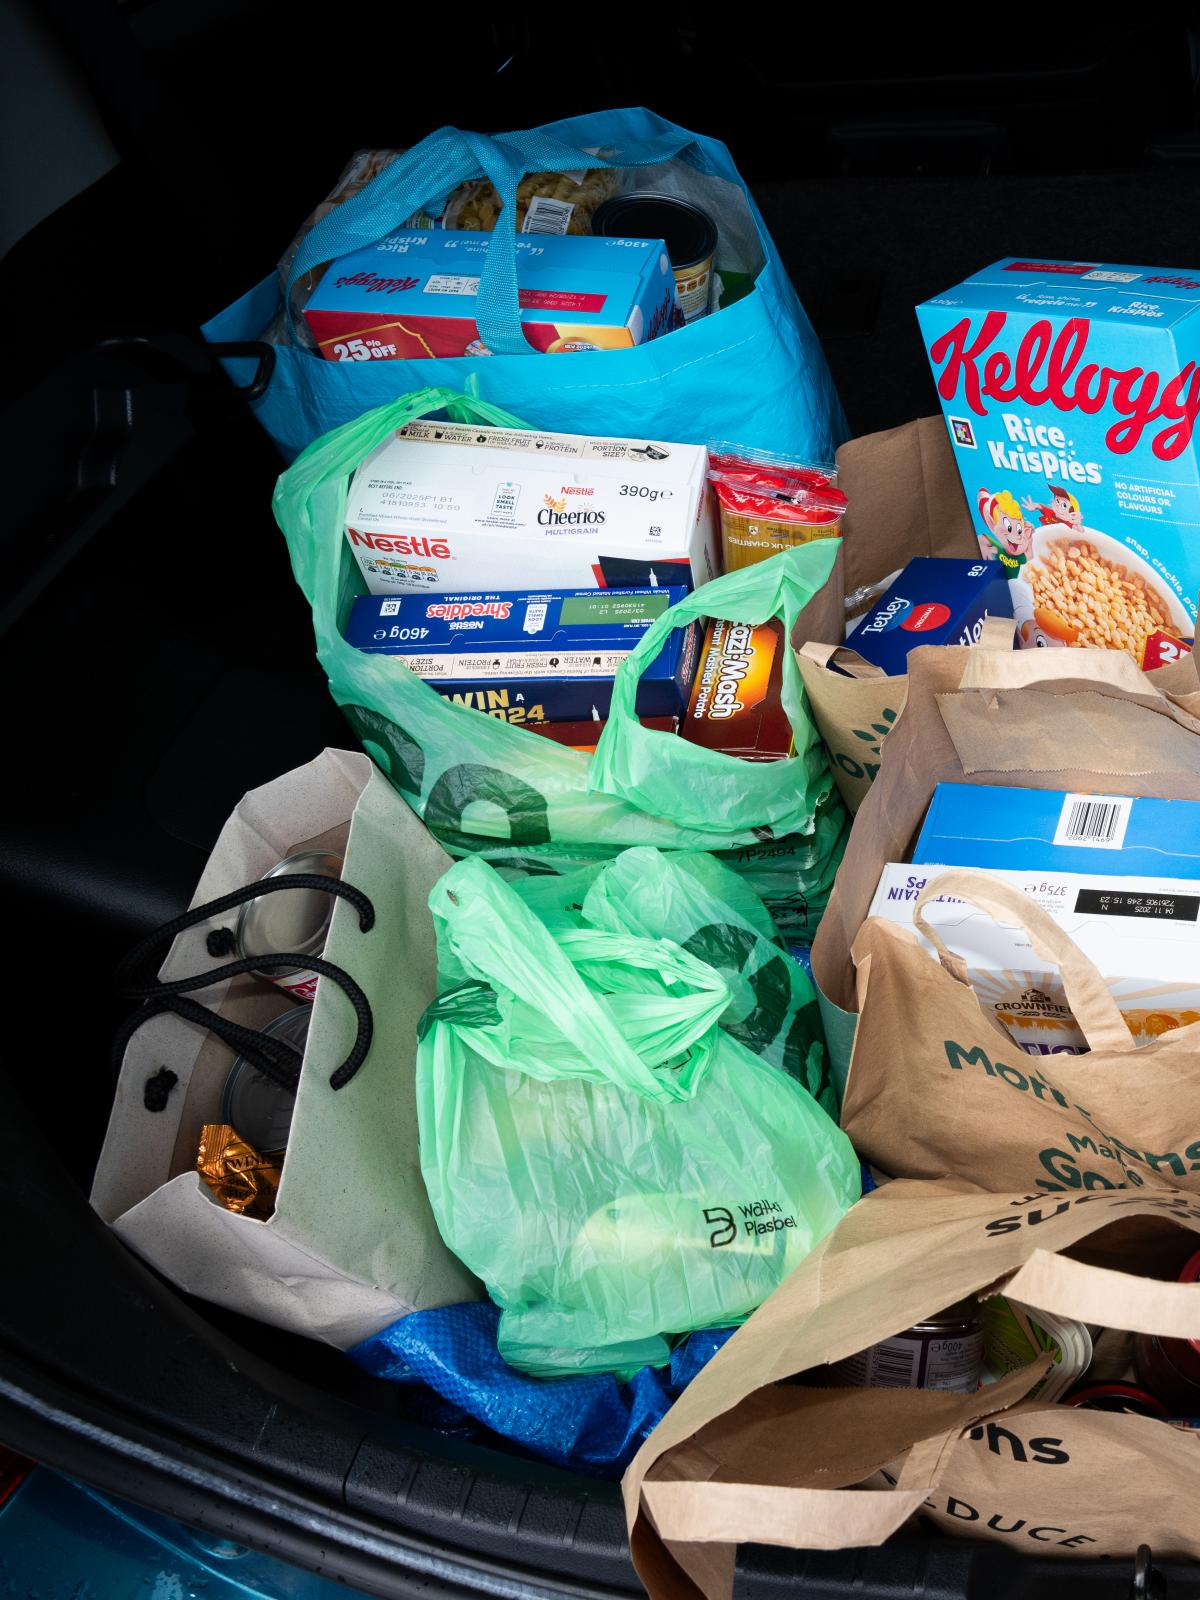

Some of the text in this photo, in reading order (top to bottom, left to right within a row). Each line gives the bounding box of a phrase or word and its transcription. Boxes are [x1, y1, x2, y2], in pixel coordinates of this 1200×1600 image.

[377, 244, 409, 253] Rice
[335, 271, 421, 294] Kellogg's
[1107, 305, 1165, 319] Krispies
[1130, 300, 1157, 311] Rice
[333, 339, 372, 361] 25
[371, 343, 398, 359] OFF
[408, 431, 430, 439] MILK
[1001, 413, 1067, 449] Rice
[444, 434, 472, 443] WATER
[488, 435, 532, 446] FRESH FRUIT
[544, 444, 579, 454] PROTEIN
[592, 445, 628, 453] PORTION
[987, 440, 1102, 486] Krispies
[1114, 481, 1176, 498] NO ARTIFICIAL
[1116, 491, 1171, 507] COLOURS OR
[1118, 501, 1163, 515] FLAVOURS
[537, 508, 606, 526] Cheerios
[545, 527, 599, 536] MULTIGRAIN
[728, 536, 766, 549] CHARITIES
[770, 542, 785, 550] UK
[968, 565, 983, 577] 80
[1125, 536, 1150, 560] snap,
[1152, 557, 1183, 596] crackle,
[426, 602, 513, 620] Shreddies
[861, 596, 910, 636] Tetley
[913, 606, 936, 629] ORIGINAL
[389, 626, 430, 641] 460g
[410, 657, 434, 666] SIZE?
[458, 659, 492, 667] PROTEIN
[563, 656, 592, 664] WATER
[410, 665, 444, 673] PORTION
[693, 618, 726, 719] nstant Mashed Potato
[442, 689, 525, 710] WIN A
[489, 705, 545, 725] 024
[736, 846, 797, 864] 7P2494
[1039, 882, 1068, 896] 375g
[1099, 896, 1124, 905] 15:23
[1127, 898, 1143, 906] 248
[1101, 904, 1109, 912] N
[738, 1199, 783, 1219] Walki
[744, 1215, 798, 1236] Plasbel
[923, 1496, 1097, 1549] DUCE
